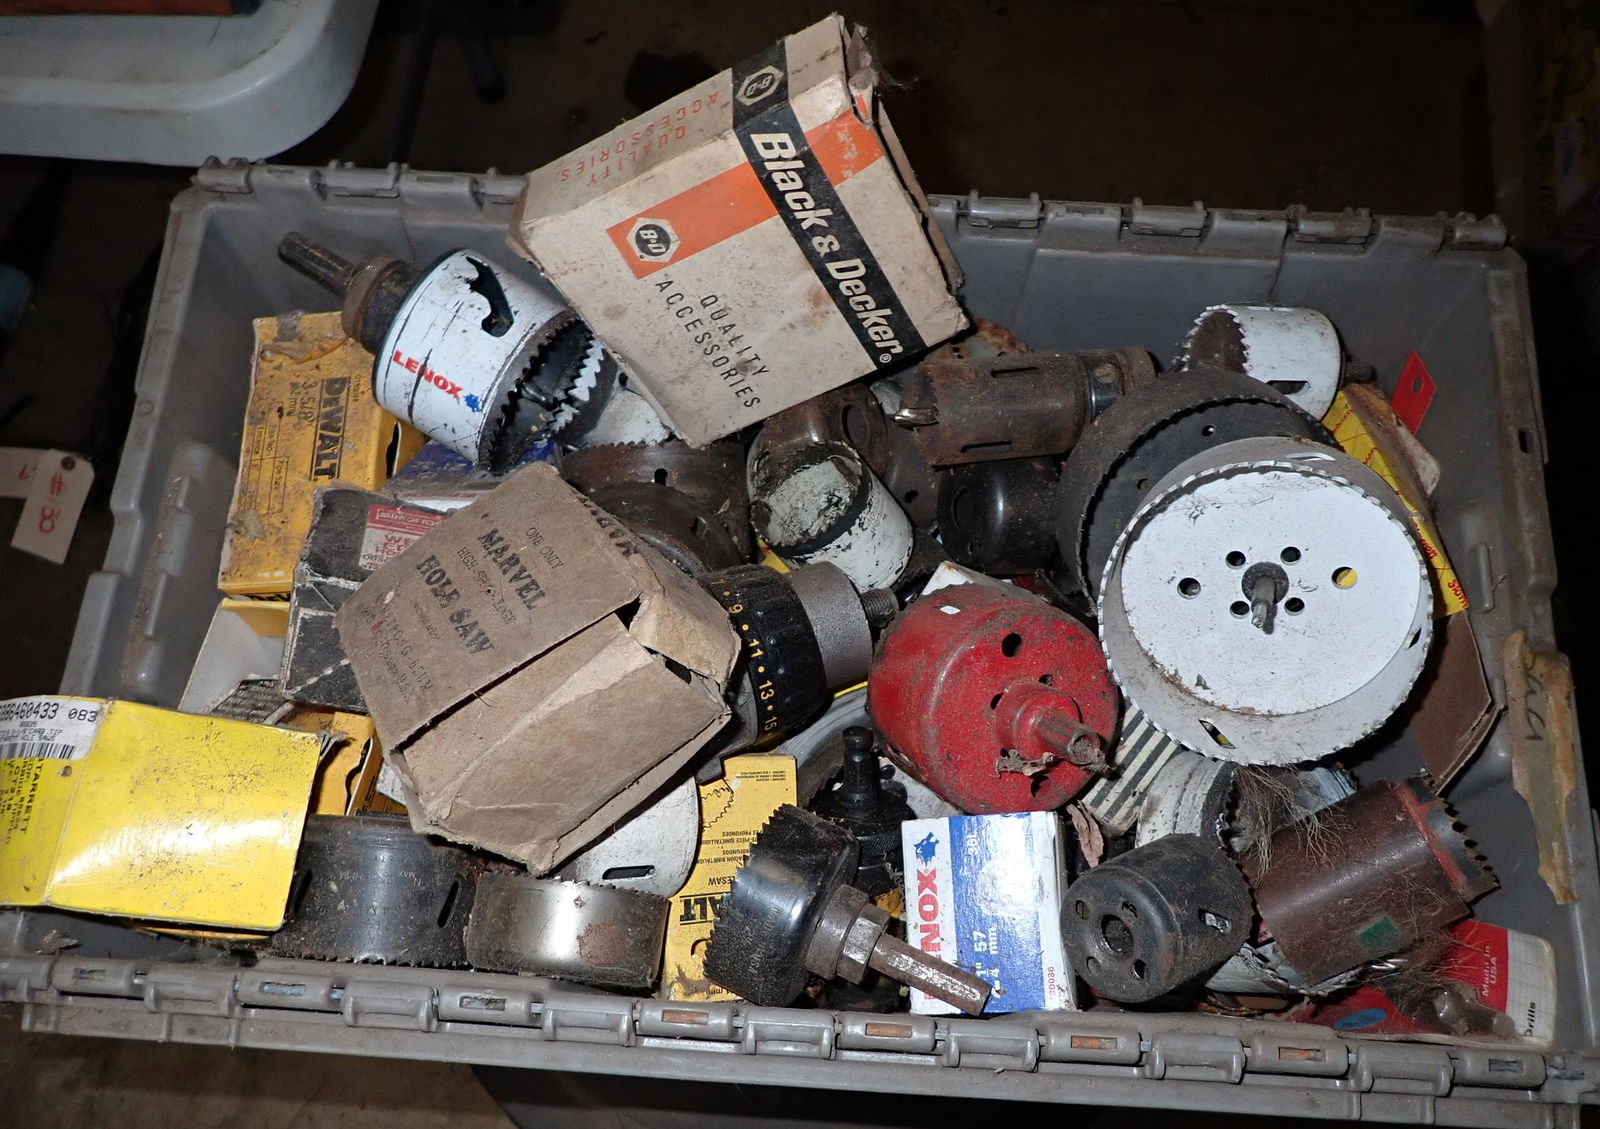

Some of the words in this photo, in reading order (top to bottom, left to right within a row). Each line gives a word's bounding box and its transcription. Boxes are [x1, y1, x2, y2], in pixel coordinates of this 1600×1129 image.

[560, 90, 720, 182] ACCESSORIES
[587, 124, 687, 187] QUALITY
[750, 132, 833, 231] Black
[812, 234, 840, 258] &
[654, 279, 761, 408] ACCESSORIES
[700, 294, 769, 377] QUALITY
[392, 349, 466, 399] LENOX
[477, 527, 546, 611] MARVEL
[525, 527, 545, 547] ONE
[539, 546, 565, 570] ONLY
[415, 554, 461, 609] HOLE
[449, 607, 495, 655] SAW
[748, 639, 764, 658] 11
[758, 679, 776, 701] 13
[68, 708, 98, 722] 083
[764, 716, 780, 731] 15
[973, 931, 987, 952] 57
[989, 927, 998, 954] mm
[1489, 956, 1497, 984] USA
